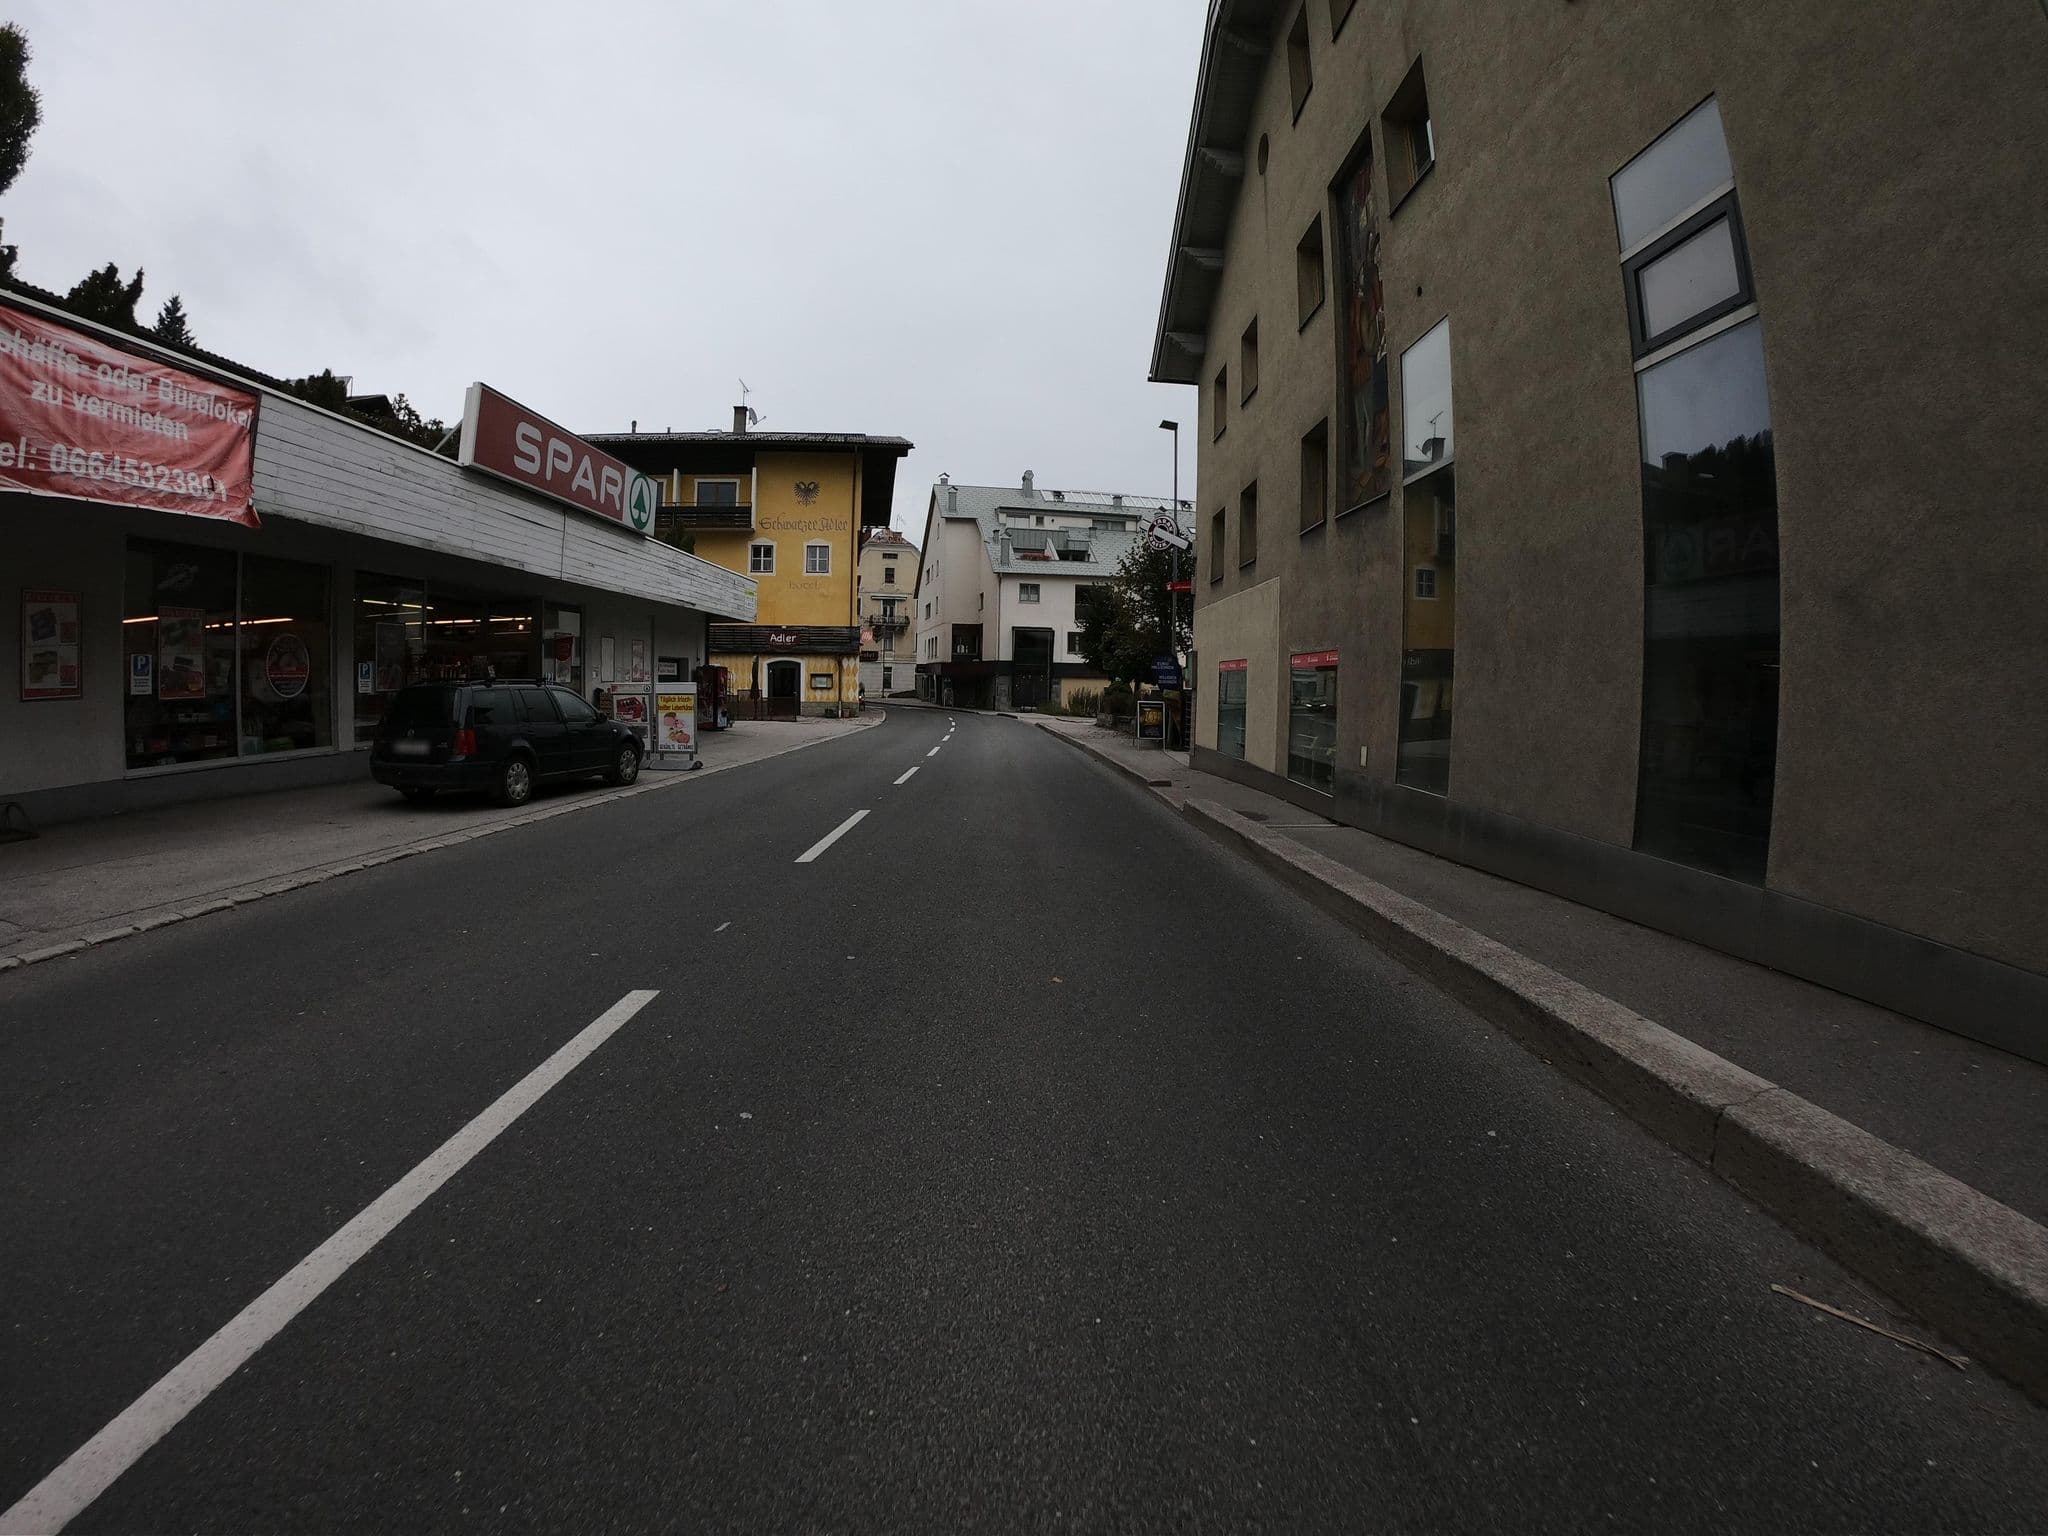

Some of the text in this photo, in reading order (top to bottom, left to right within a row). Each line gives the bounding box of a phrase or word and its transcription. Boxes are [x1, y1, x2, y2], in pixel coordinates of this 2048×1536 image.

[31, 380, 188, 441] zu vermieten
[98, 362, 152, 392] oder
[158, 376, 253, 429] Bürolokal
[513, 421, 623, 511] SPAR
[770, 633, 797, 643] Adler
